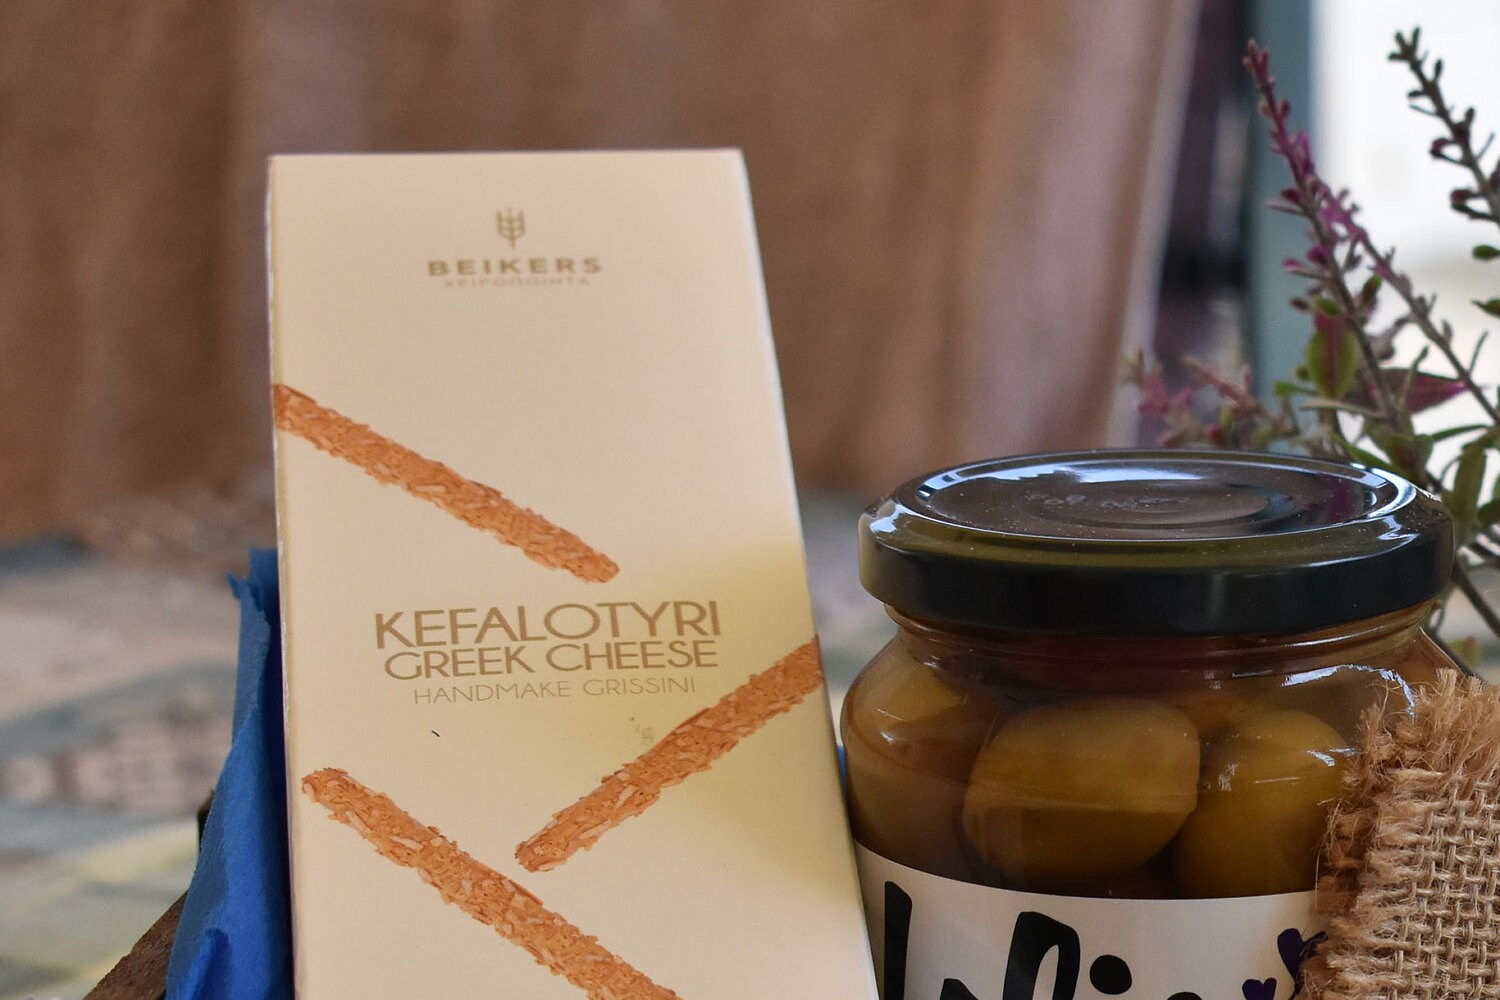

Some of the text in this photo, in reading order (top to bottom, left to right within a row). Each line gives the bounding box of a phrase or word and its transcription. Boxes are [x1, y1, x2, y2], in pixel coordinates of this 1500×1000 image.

[427, 257, 602, 277] BEIKERS
[374, 600, 722, 650] KEFALOTYRI
[384, 639, 720, 681] GREEK CHEESE
[413, 676, 696, 704] HANDMAKE GRISSINI
